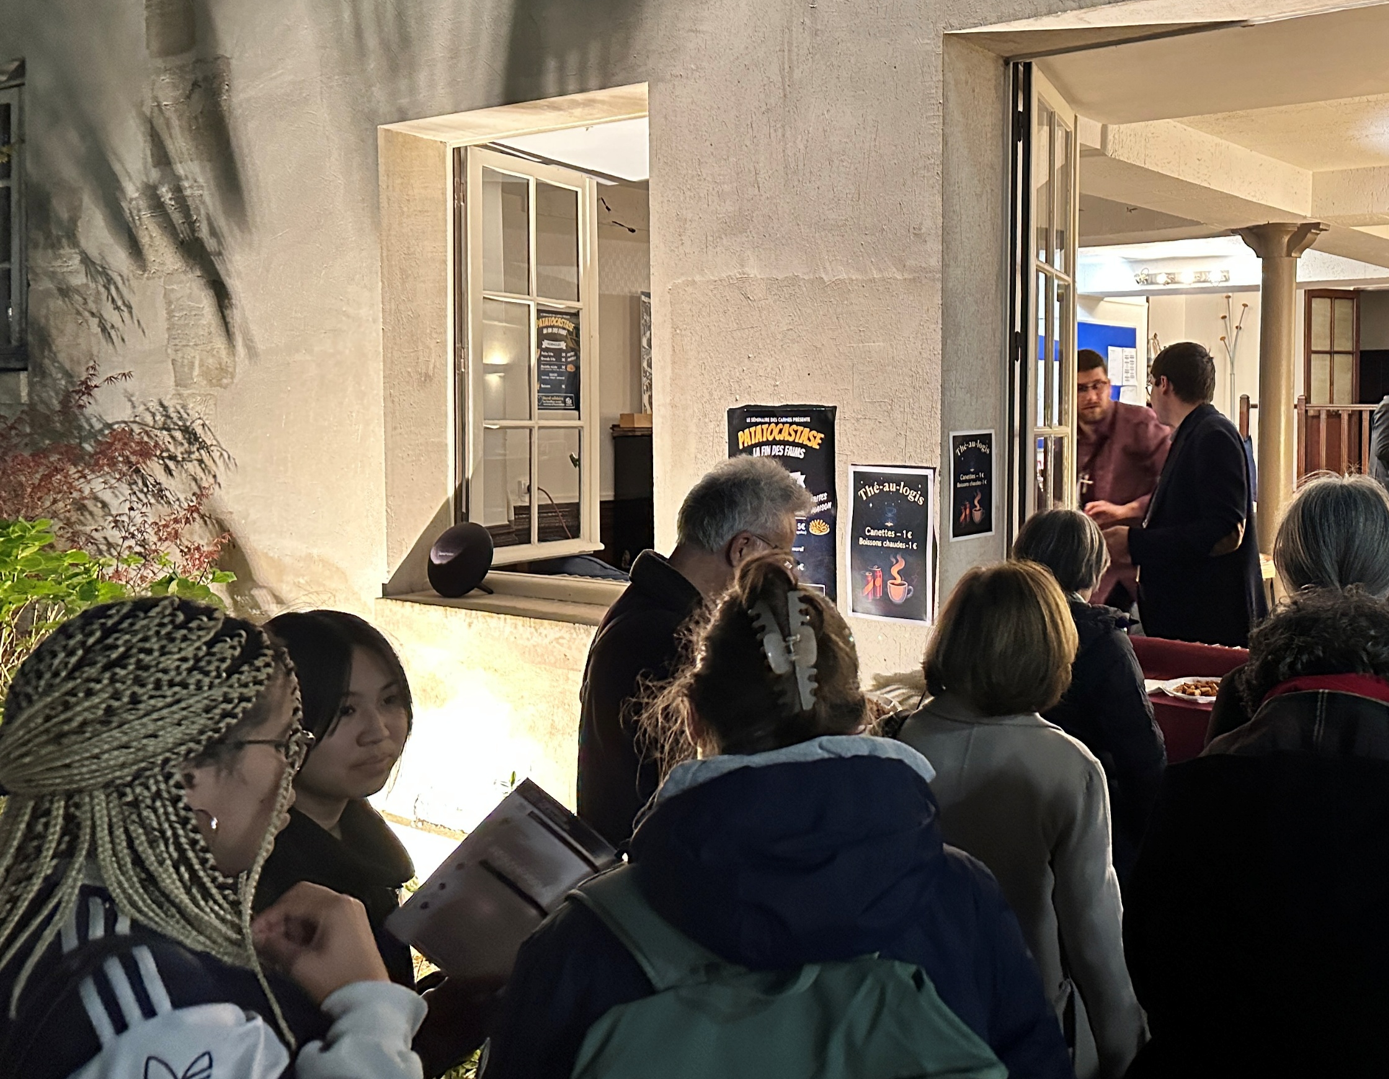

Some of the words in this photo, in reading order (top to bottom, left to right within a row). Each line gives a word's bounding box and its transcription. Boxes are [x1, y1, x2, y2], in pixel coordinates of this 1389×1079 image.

[738, 423, 825, 450] PATATOCASTASE
[753, 446, 761, 457] LA
[761, 445, 771, 456] FIN
[772, 445, 785, 456] DES
[785, 445, 806, 459] FAIMS
[858, 481, 925, 506] Thé-au-logis
[865, 527, 895, 537] Canettes
[859, 537, 882, 547] Boissons
